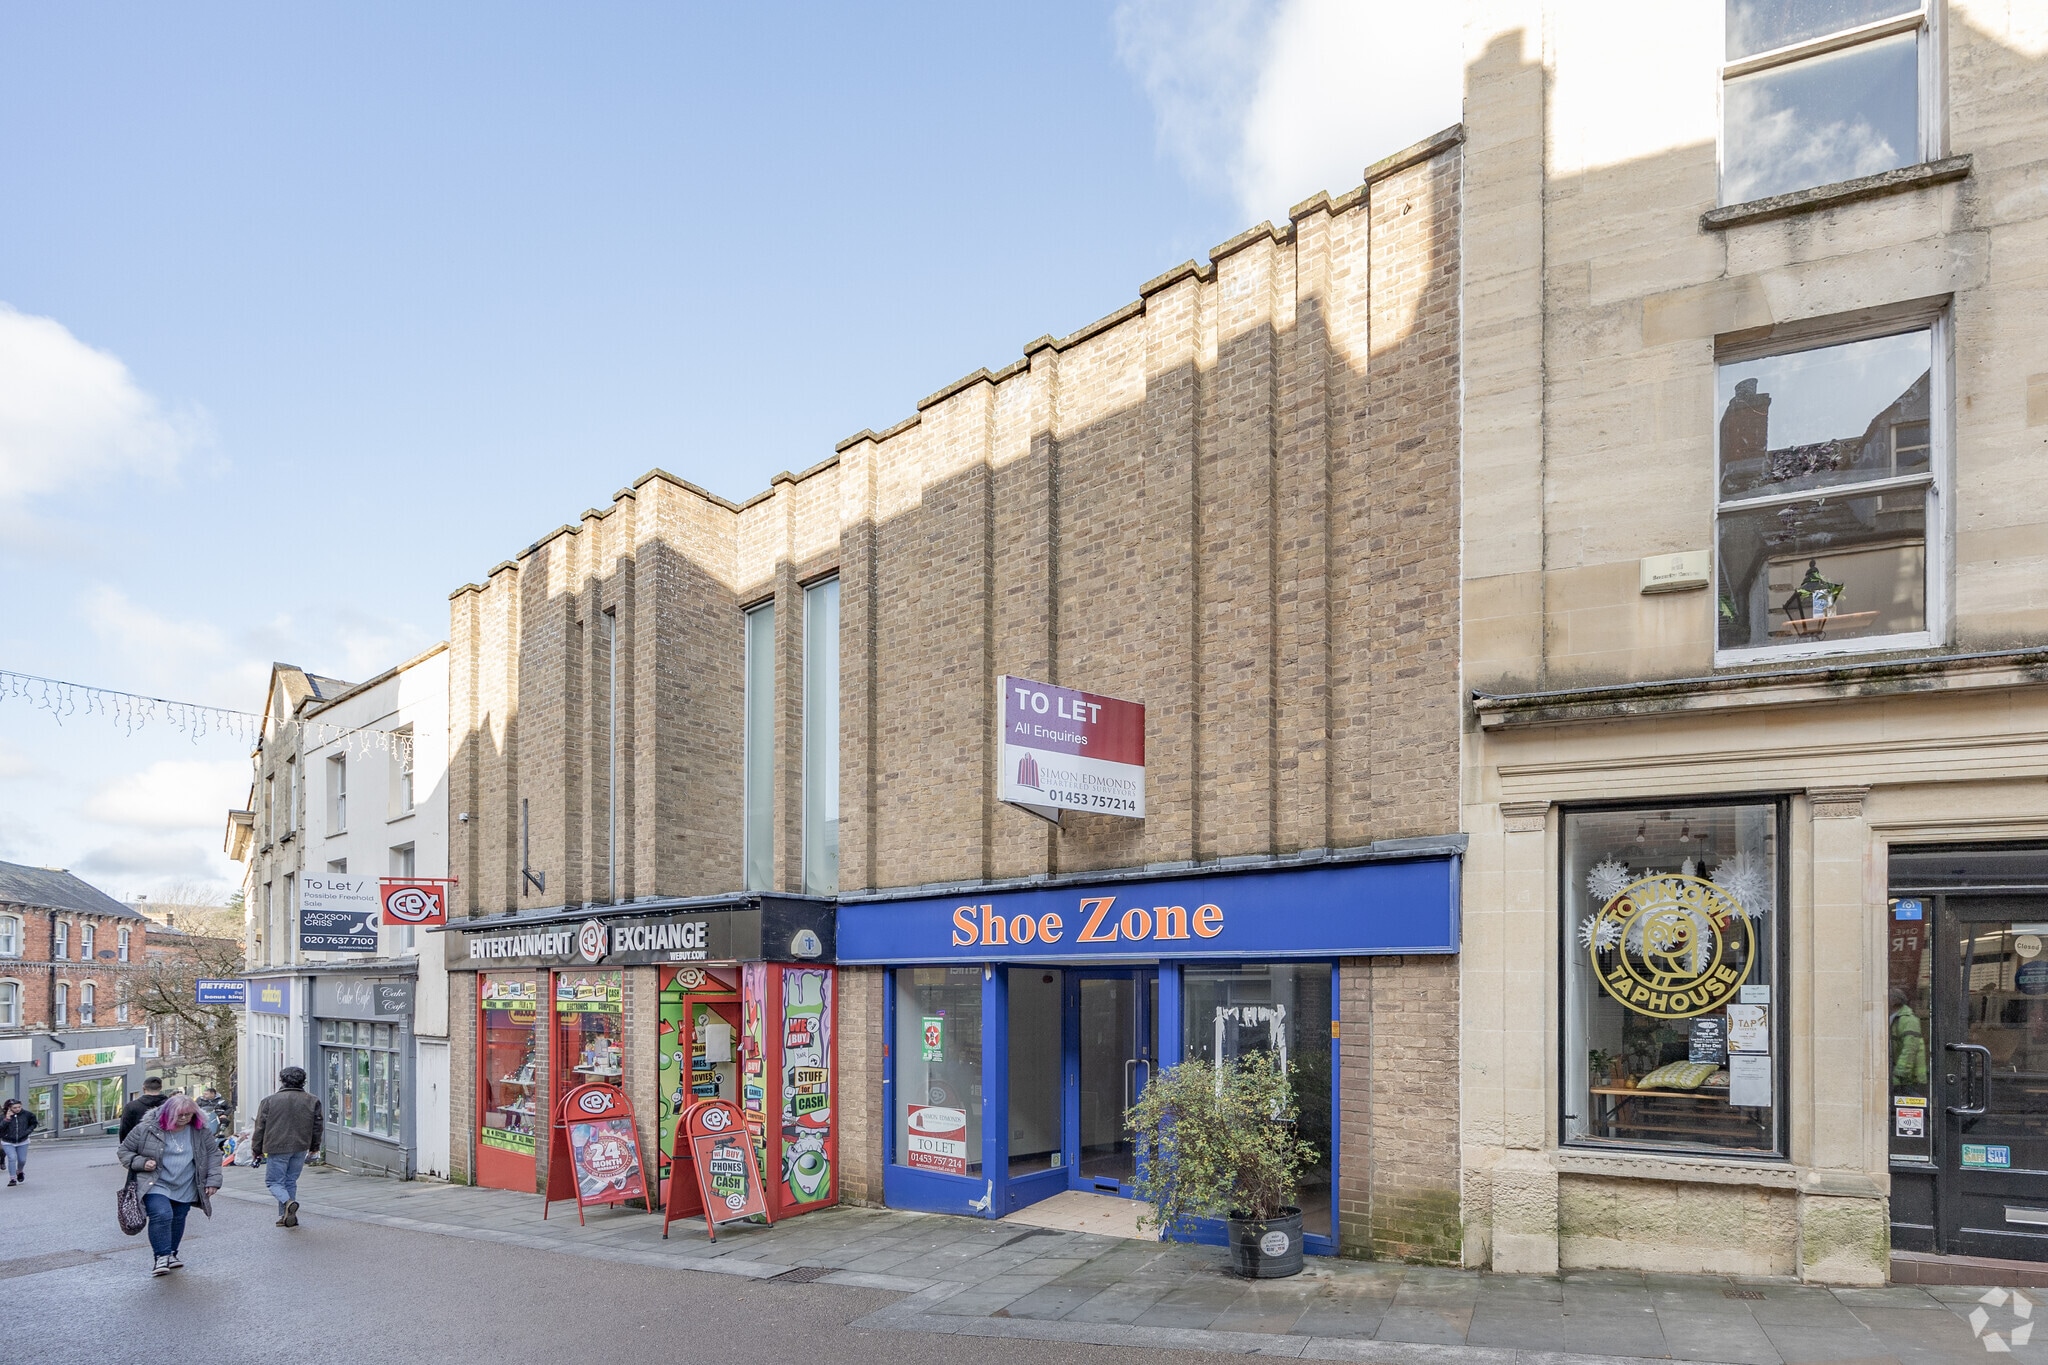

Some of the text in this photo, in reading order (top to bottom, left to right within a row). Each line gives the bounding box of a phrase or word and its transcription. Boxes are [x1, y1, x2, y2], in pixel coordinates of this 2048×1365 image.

[1014, 688, 1102, 724] TO LET
[1014, 722, 1088, 745] All Enquiries
[1040, 768, 1136, 790] SIMON EDMONDS
[1040, 778, 1136, 796] CHARTERED SURVEYORS
[1050, 790, 1136, 811] 01453 757214
[304, 878, 322, 890] To
[327, 880, 352, 891] Let
[1607, 883, 1732, 928] TOWN OWL
[952, 896, 1224, 947] Shoe Zone
[470, 932, 573, 959] ENTERTAINMENT
[614, 922, 708, 951] EXCHANGE
[670, 951, 707, 961] WEBUY.COM
[336, 982, 353, 1004] Cake
[1607, 964, 1739, 1011] TAPHOUSE
[379, 986, 407, 1012] Cake Café
[789, 1018, 807, 1032] WE
[791, 1033, 807, 1043] BUY
[692, 1045, 706, 1053] PHON
[76, 1050, 118, 1067] SUBWAY
[692, 1073, 713, 1082] OVIES
[798, 1071, 822, 1081] STUFF
[798, 1096, 824, 1111] CASH
[590, 1142, 621, 1162] 24
[918, 1138, 955, 1154] TO LET
[726, 1150, 740, 1158] BUY
[911, 1153, 962, 1168] 01453 757 214
[1988, 1154, 2007, 1163] SAFE
[593, 1158, 622, 1168] MONTH
[712, 1162, 742, 1172] PHONES
[716, 1176, 740, 1188] CASH
